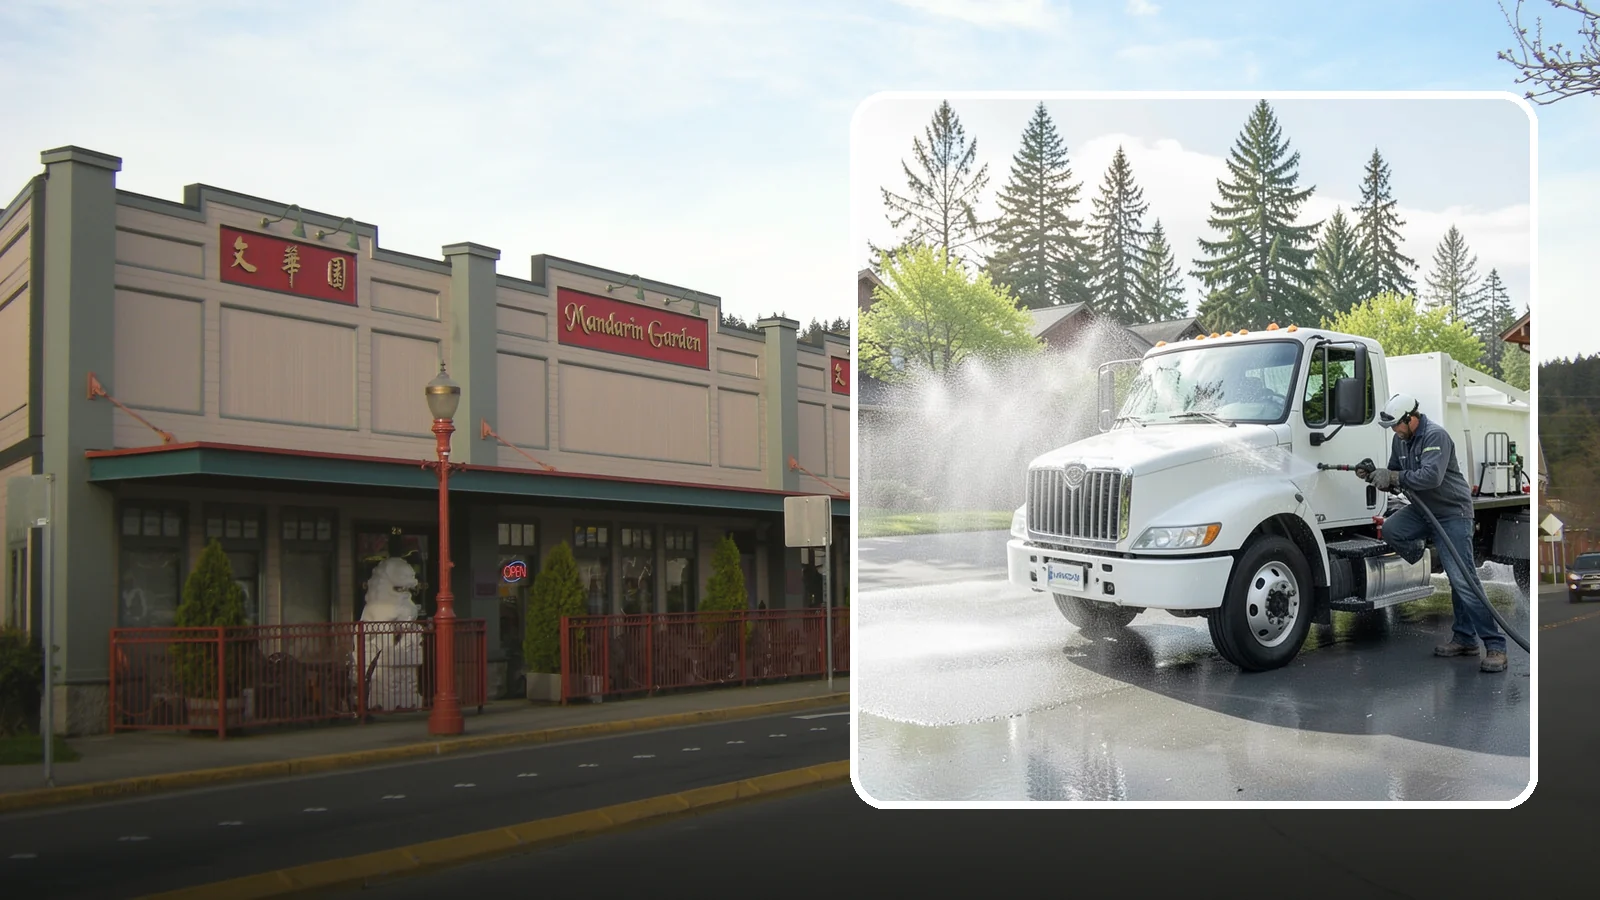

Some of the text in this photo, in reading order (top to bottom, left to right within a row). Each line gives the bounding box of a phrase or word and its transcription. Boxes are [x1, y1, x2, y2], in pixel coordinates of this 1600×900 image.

[564, 302, 702, 352] Mandarin Garden
[503, 565, 527, 578] OPEN
